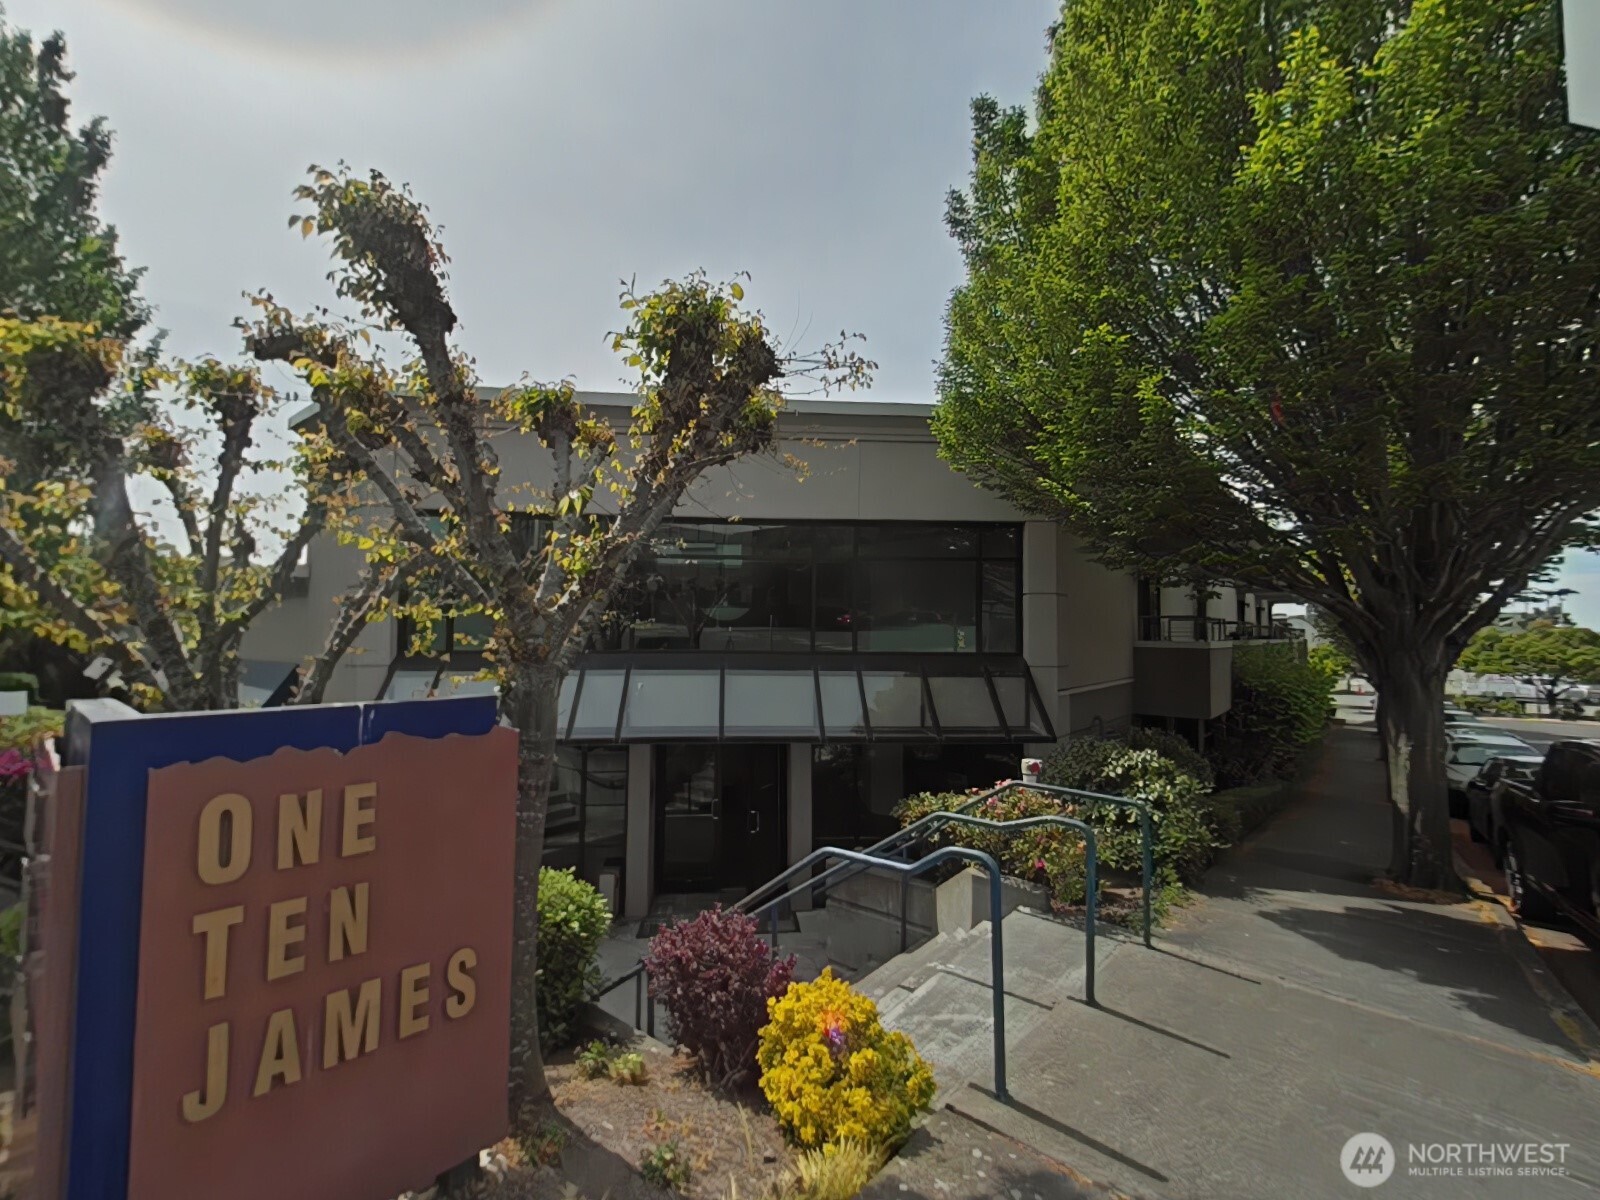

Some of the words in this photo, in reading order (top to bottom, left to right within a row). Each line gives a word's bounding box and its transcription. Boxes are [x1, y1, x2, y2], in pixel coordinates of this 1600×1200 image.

[198, 782, 377, 885] ONE
[192, 882, 369, 1000] TEN
[182, 947, 478, 1122] JAMES
